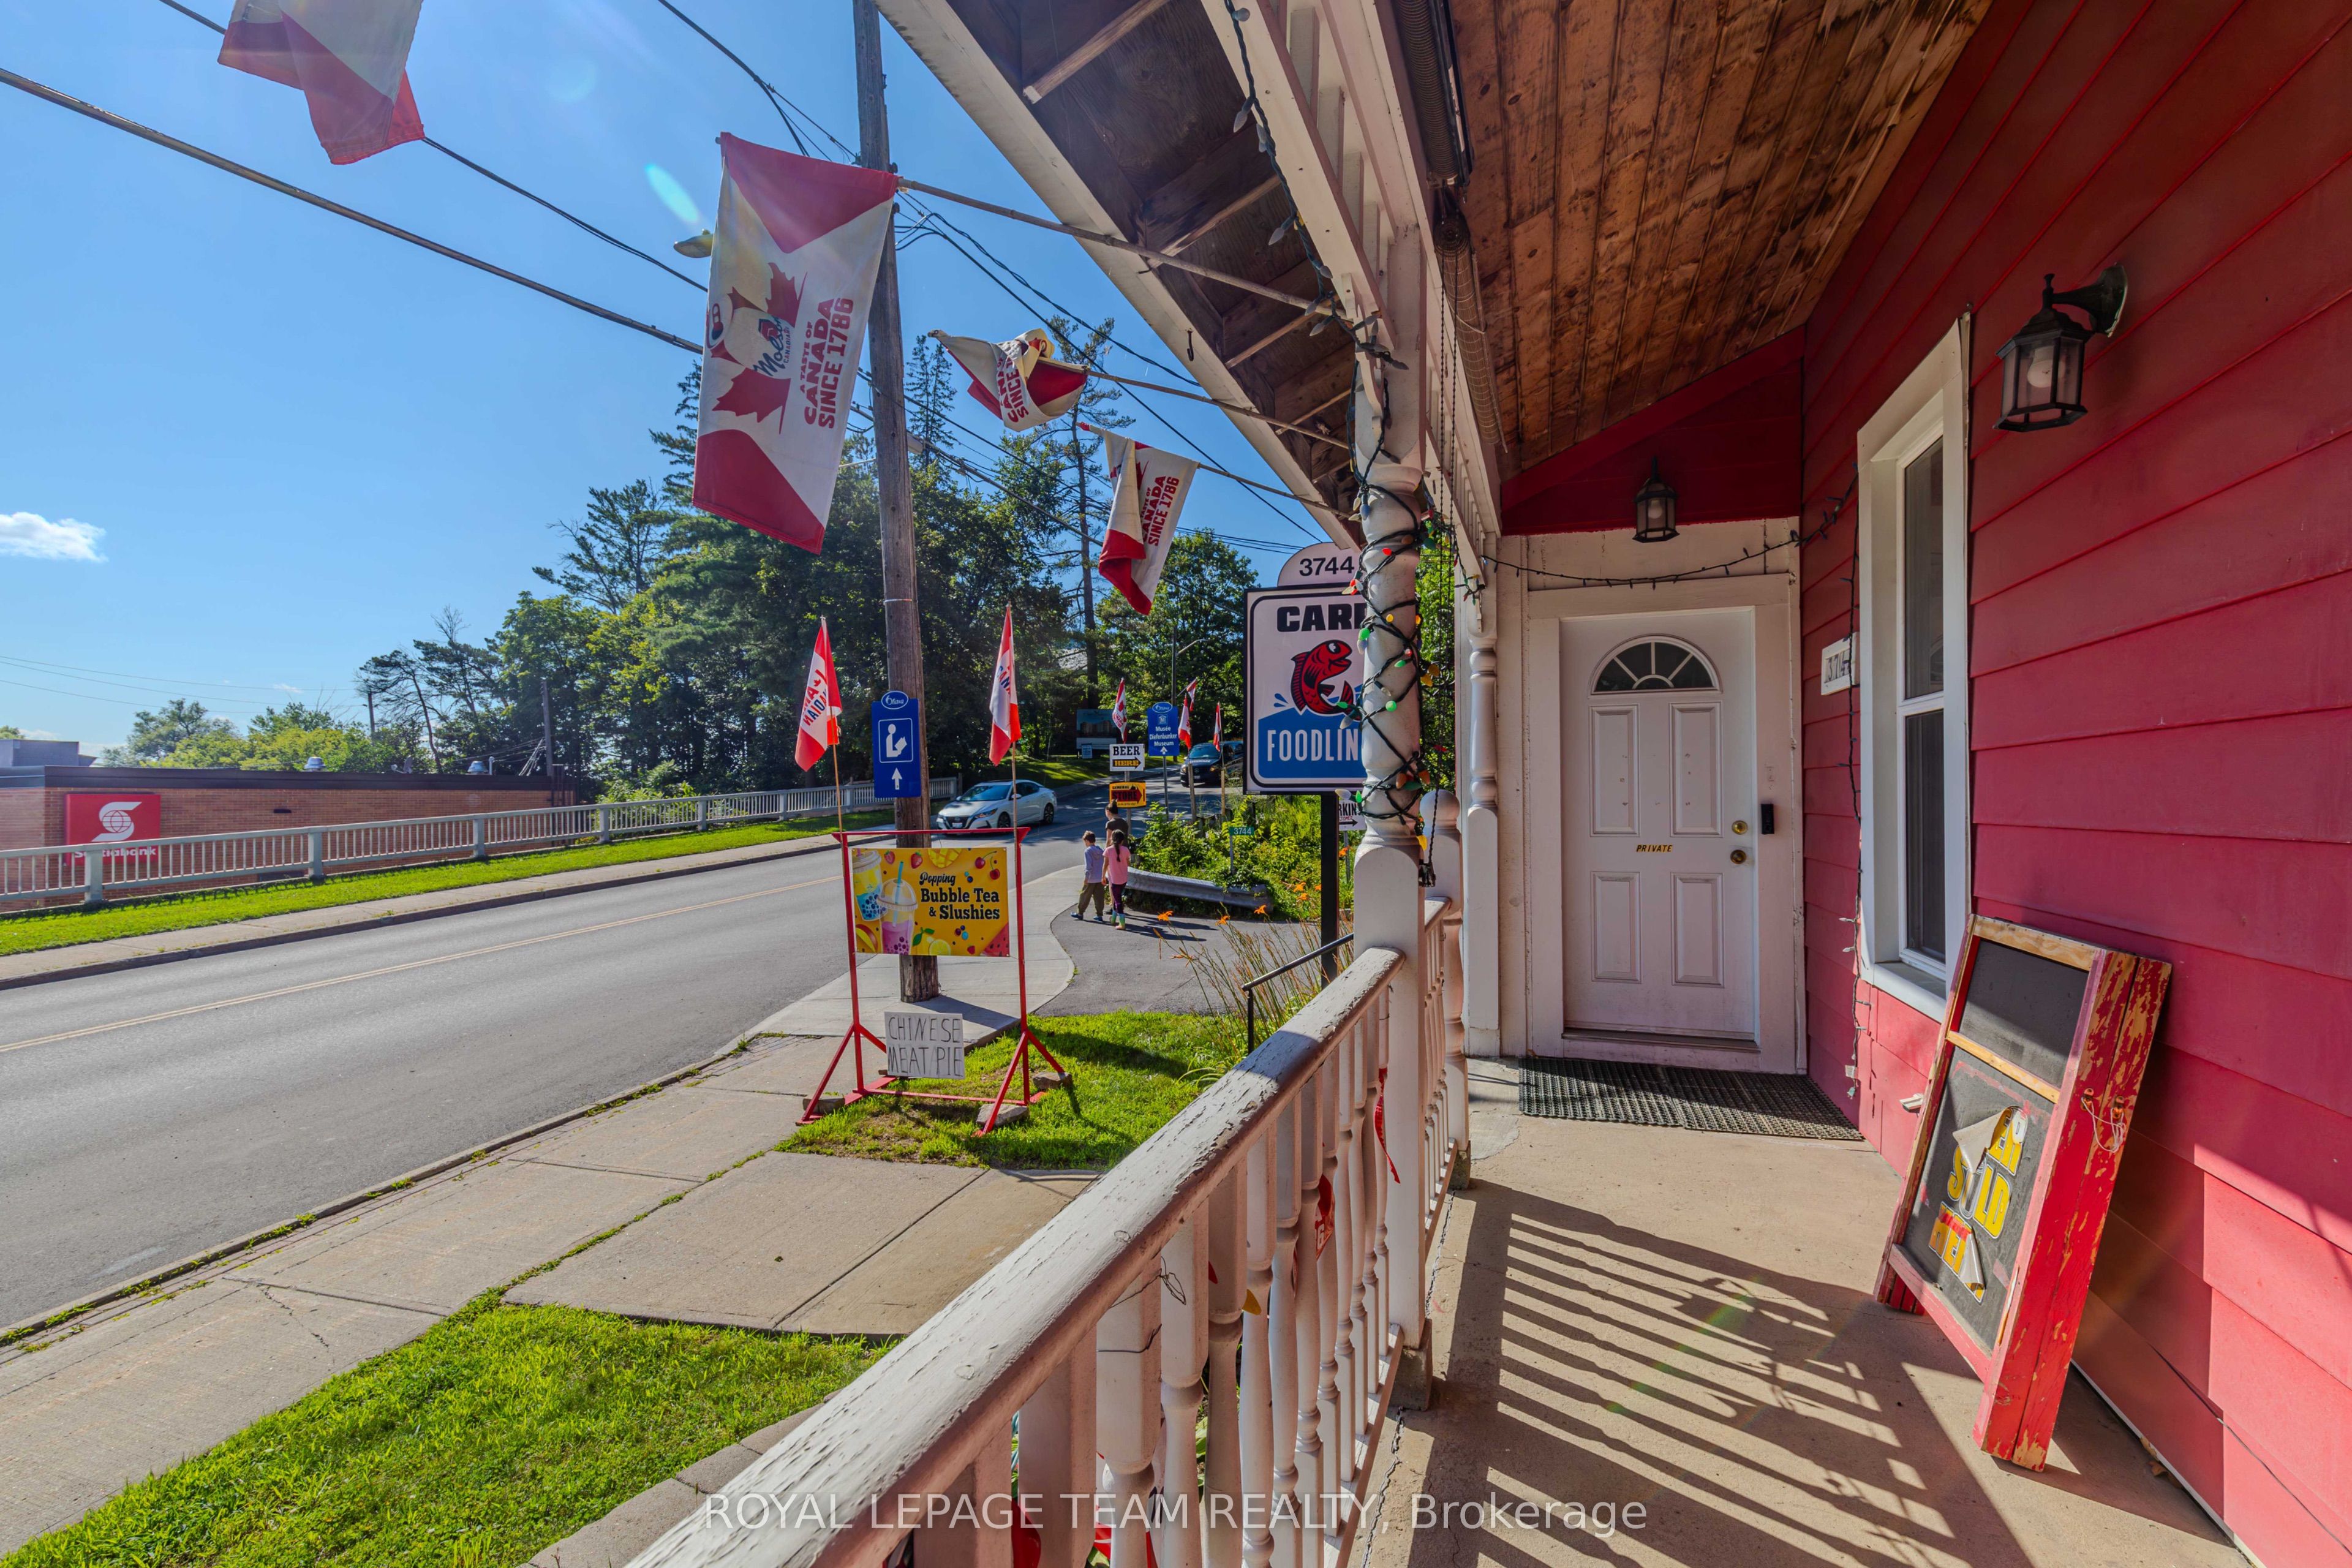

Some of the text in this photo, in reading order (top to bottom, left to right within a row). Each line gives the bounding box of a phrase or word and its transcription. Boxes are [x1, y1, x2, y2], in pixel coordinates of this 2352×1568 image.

[753, 315, 786, 377] Molson
[800, 321, 813, 394] A TASTE OF
[804, 298, 835, 424] CANADA
[818, 298, 853, 429] SINCE 1786
[1006, 369, 1029, 418] SINCE
[1148, 477, 1180, 546] SINCE 1786
[1299, 556, 1354, 576] 3744
[1113, 746, 1140, 756] BEER
[919, 872, 956, 886] Popping
[921, 888, 1000, 902] Bubble Tea
[929, 904, 1000, 919] & Slushies
[889, 1017, 961, 1042] CHINESE
[888, 1046, 963, 1077] MEAT PIE
